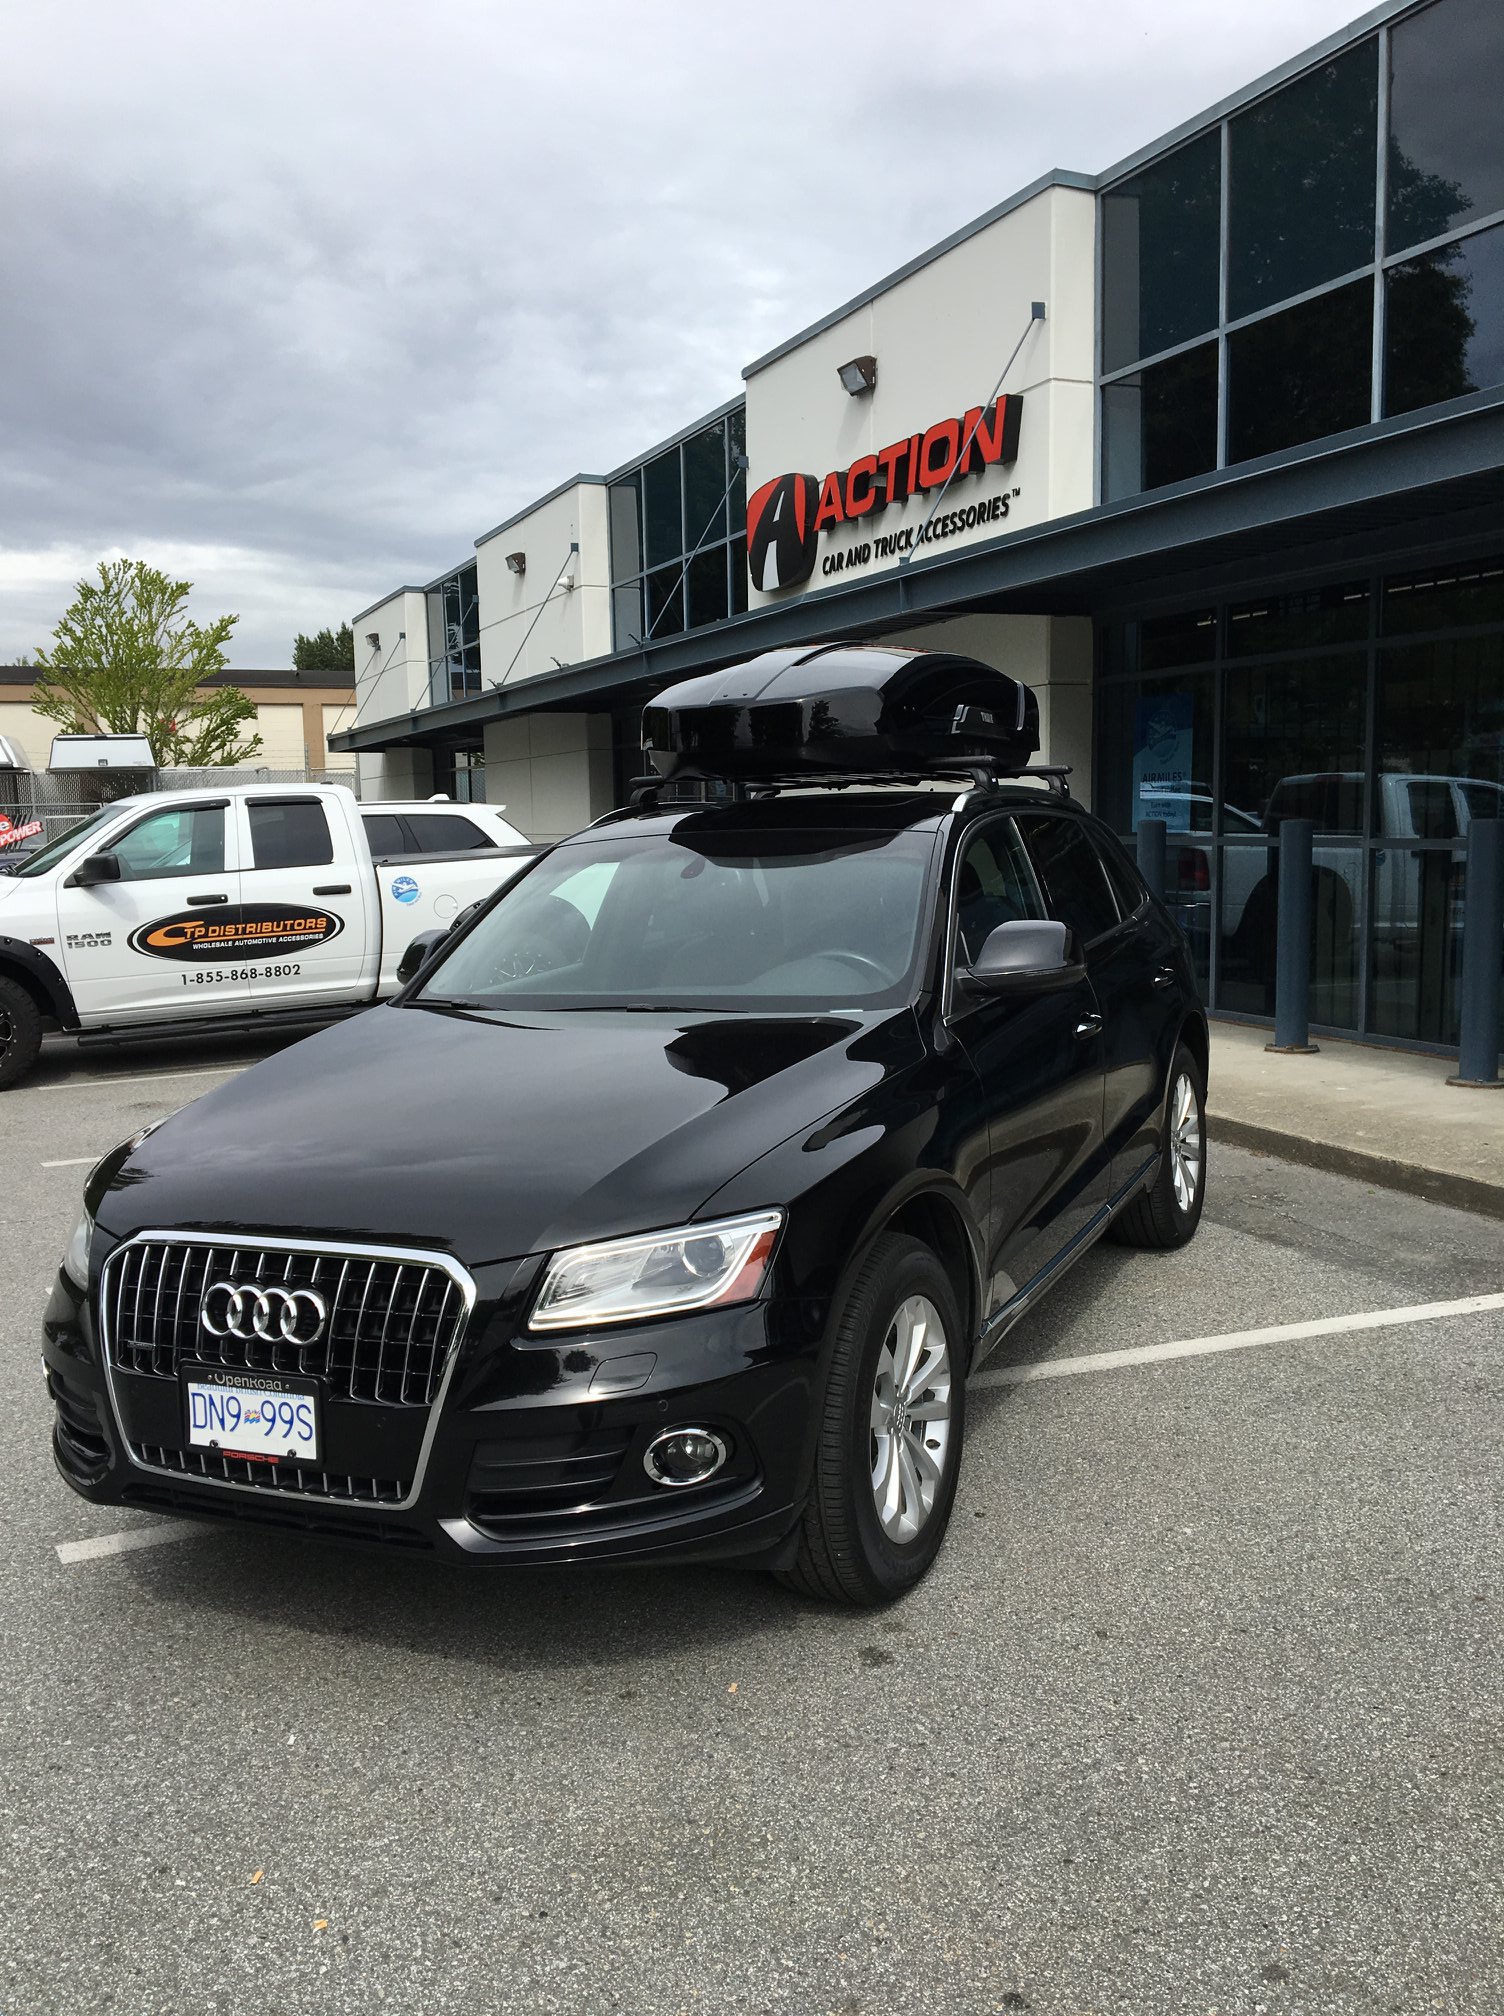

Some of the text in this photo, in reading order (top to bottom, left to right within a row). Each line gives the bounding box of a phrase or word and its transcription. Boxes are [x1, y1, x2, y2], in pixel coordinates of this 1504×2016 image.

[814, 394, 1021, 533] ACTION
[822, 552, 845, 576] CAR
[845, 542, 871, 569] AND
[873, 527, 914, 560] TRUCK
[914, 493, 1011, 543] ACCESSORIES
[66, 931, 112, 942] RAM
[208, 917, 327, 937] DISTRIBUTORS
[67, 939, 112, 949] 1500
[192, 933, 324, 950] WHOLESALE AUTOMOTIVE ACCESSORIES
[181, 964, 301, 986] 1-855-868-8802
[214, 1373, 282, 1391] OpenRoad
[191, 1392, 313, 1441] DN9 99S
[223, 1450, 279, 1464] PORSCHE
